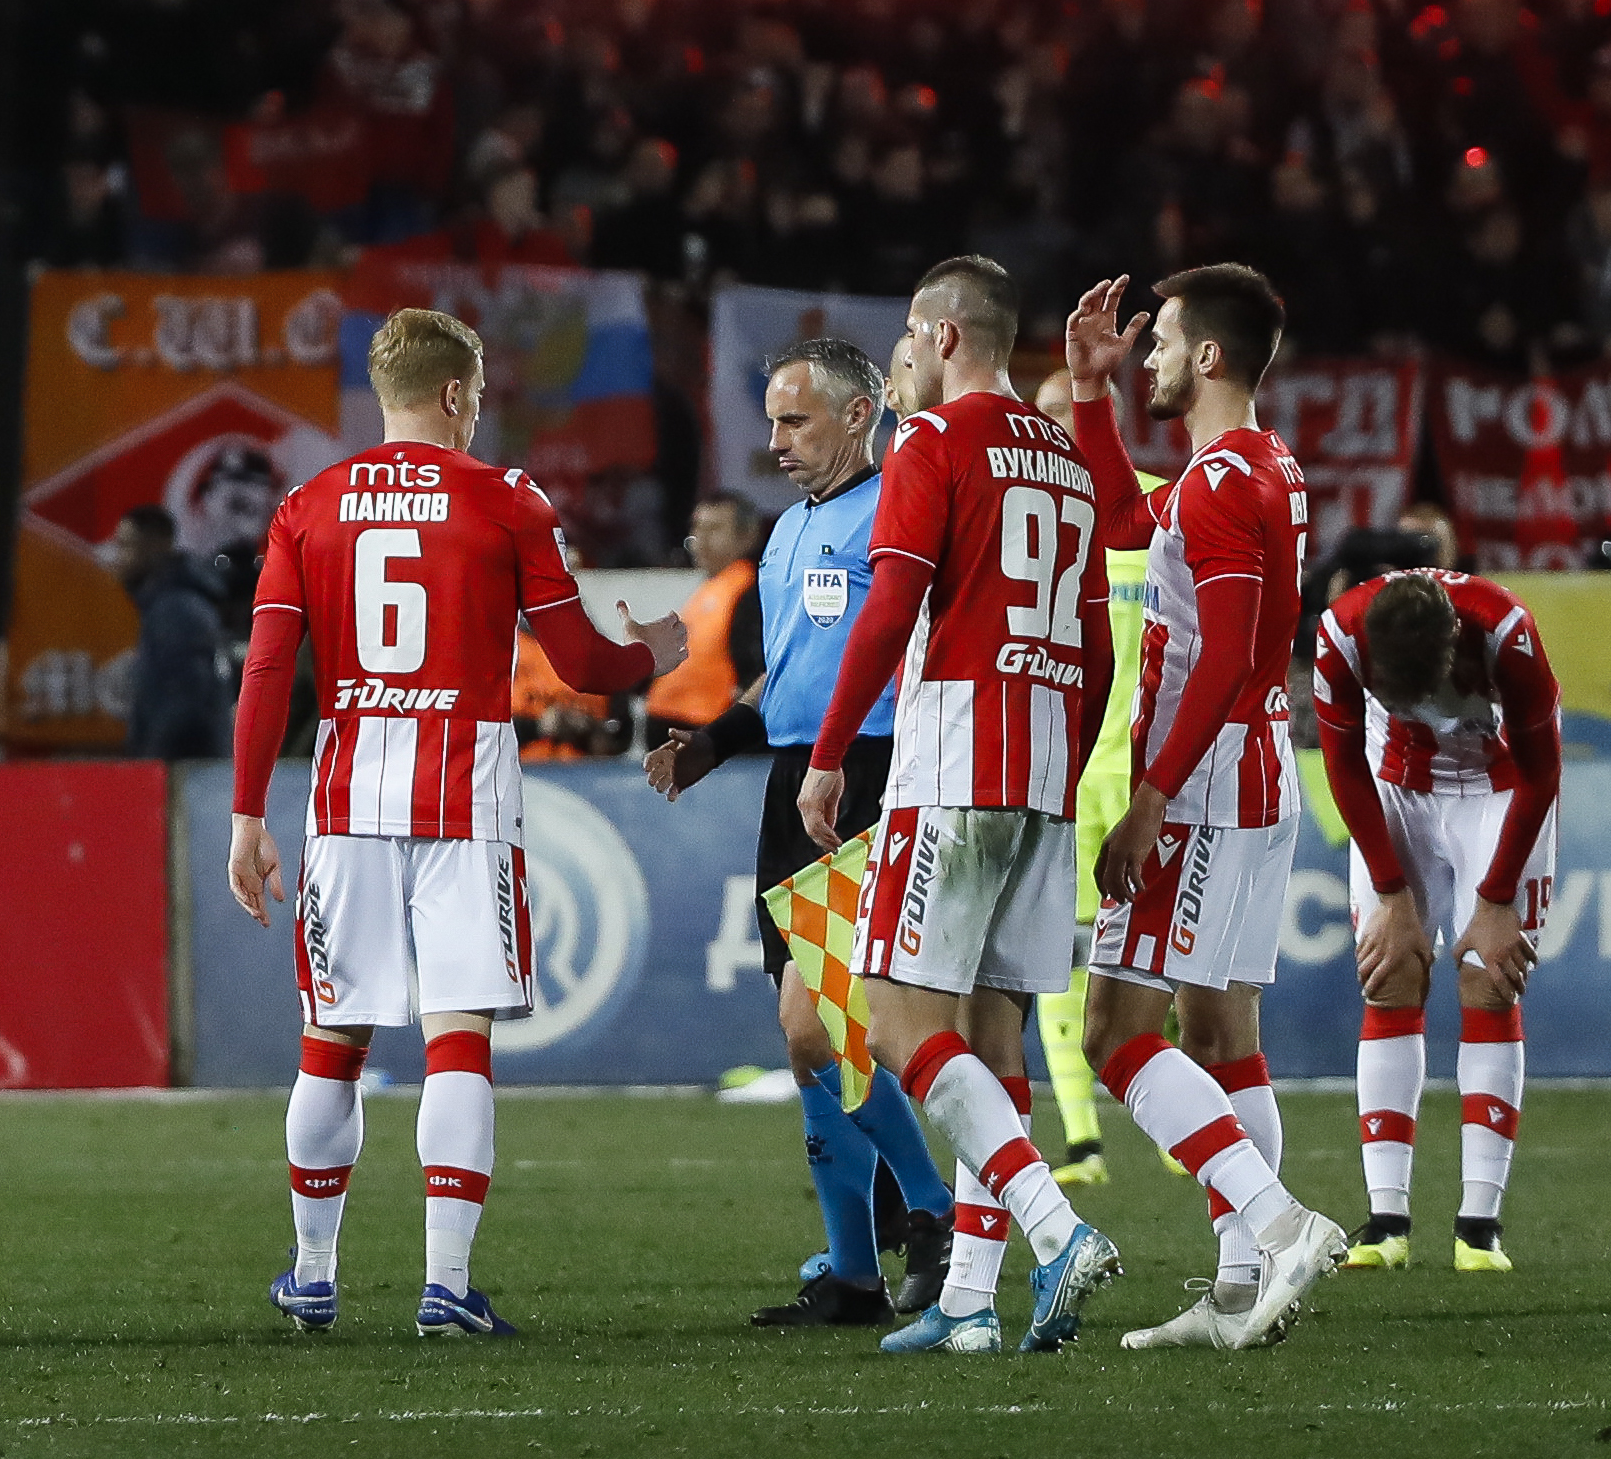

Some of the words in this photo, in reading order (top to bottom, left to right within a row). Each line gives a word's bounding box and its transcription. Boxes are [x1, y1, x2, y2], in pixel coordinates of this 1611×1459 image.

[1006, 412, 1071, 452] mts
[349, 460, 442, 488] mts
[338, 491, 451, 523] ПАНКОВ
[807, 573, 843, 588] FIFA
[1000, 485, 1095, 649] 92
[353, 527, 428, 674] 6
[898, 821, 939, 957] G-DRIVE
[304, 1176, 340, 1189] ФК
[429, 1174, 462, 1188] ФК
